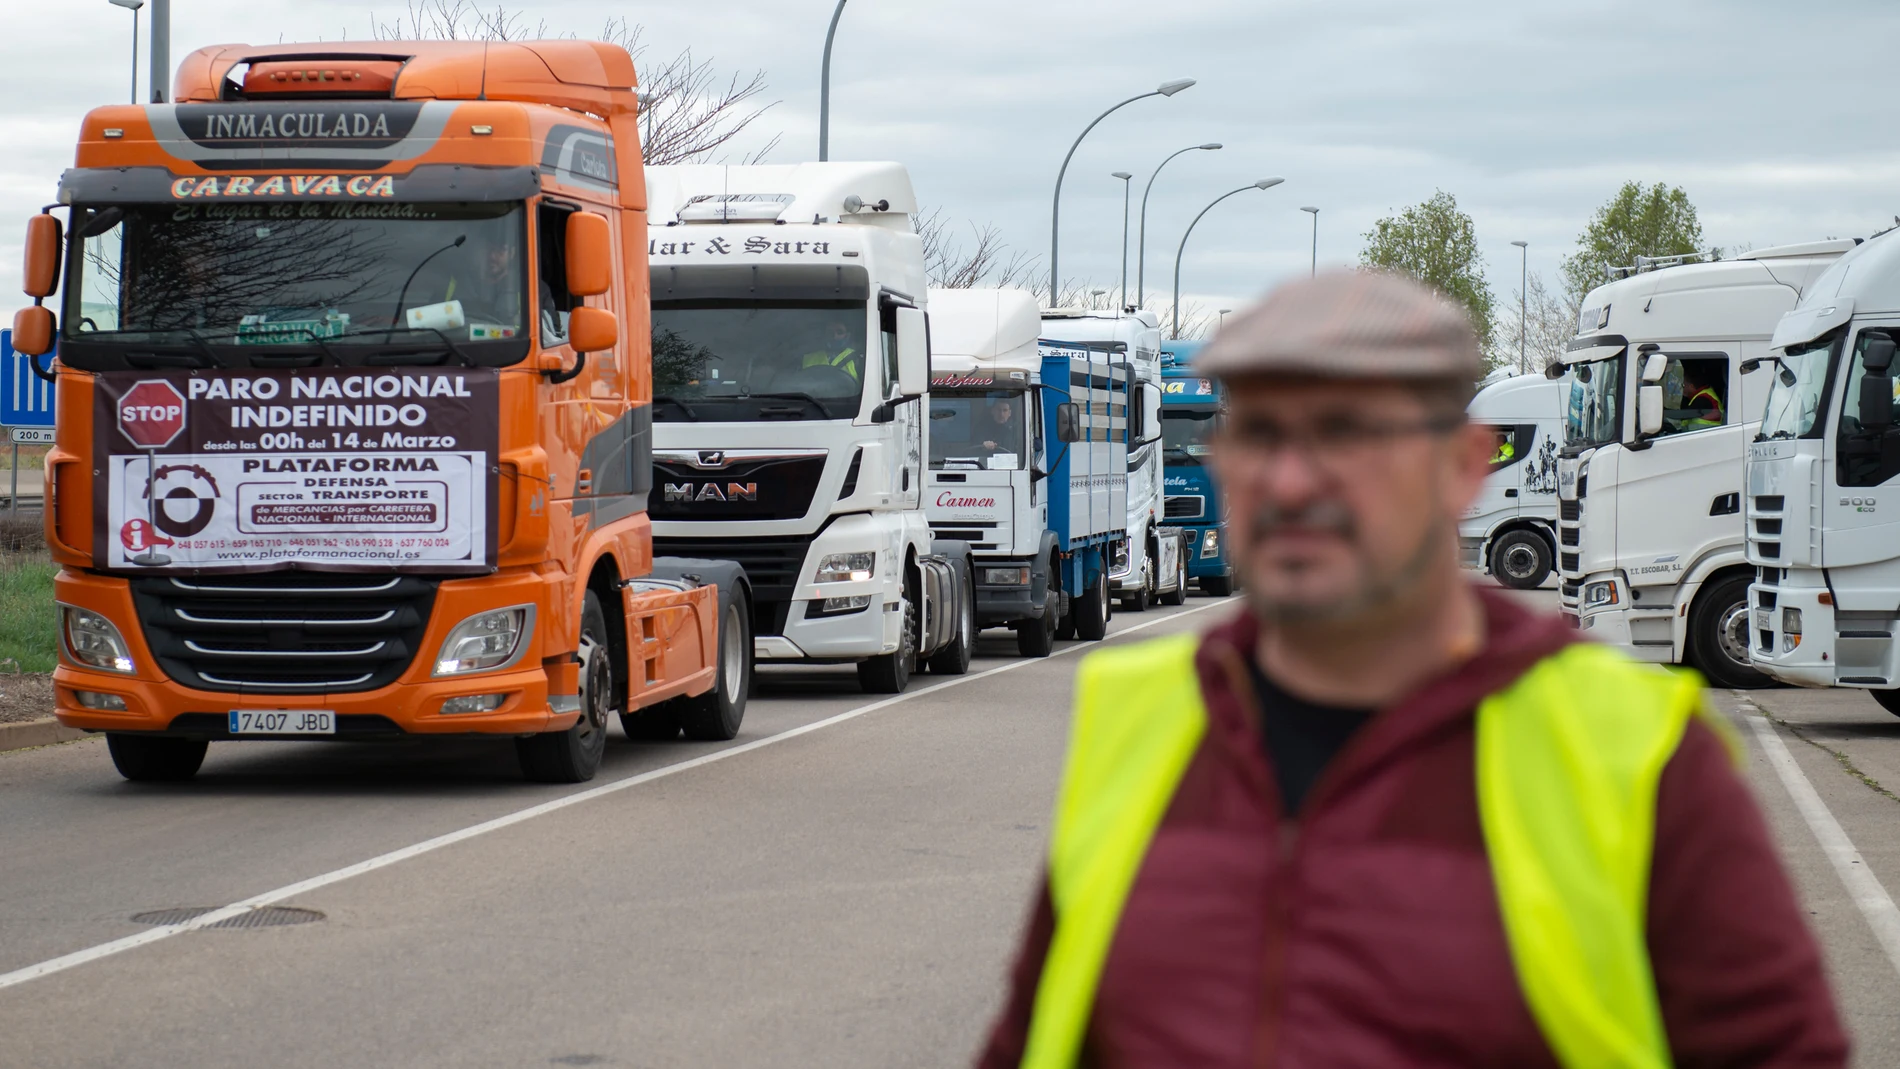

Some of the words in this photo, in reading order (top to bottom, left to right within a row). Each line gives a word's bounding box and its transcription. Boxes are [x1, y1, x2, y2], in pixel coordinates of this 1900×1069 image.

[205, 113, 390, 138] INMACULADA
[171, 175, 395, 198] CARAVACA
[172, 203, 197, 221] El
[205, 203, 262, 223] lugar
[269, 202, 294, 217] de
[298, 202, 320, 217] la
[648, 239, 696, 256] lar
[705, 235, 731, 255] &
[742, 235, 830, 256] Sara
[188, 377, 280, 400] PARO
[290, 375, 471, 398] NACIONAL
[931, 372, 993, 387] ntejano
[122, 405, 181, 422] STOP
[231, 404, 427, 428] INDEFINIDO
[19, 431, 39, 440] 200
[203, 441, 237, 450] desde
[239, 440, 257, 449] las
[259, 432, 304, 450] 00h
[307, 439, 326, 449] del
[331, 432, 360, 448] 14
[362, 439, 378, 448] de
[380, 432, 456, 448] Marzo
[243, 457, 439, 473] PLATAFORMA
[304, 477, 389, 487] DEFENSA
[1163, 476, 1187, 486] tela
[312, 490, 429, 500] TRANSPORTE
[664, 482, 757, 501] MAN
[936, 491, 996, 508] Carmen
[1839, 497, 1876, 506] 500
[256, 506, 270, 514] de
[272, 505, 346, 513] MERCANCIAS
[347, 506, 366, 515] por
[368, 505, 431, 513] CARRETERA
[257, 514, 321, 523] NACIONAL
[333, 514, 431, 523] INTERNACIONAL
[178, 540, 191, 549] 648
[194, 540, 207, 549] 057
[210, 540, 225, 548] 615
[232, 539, 247, 548] 659
[250, 539, 264, 547] 165
[267, 539, 281, 547] 710
[306, 539, 320, 547] 051
[345, 539, 359, 547] 616
[362, 539, 376, 547] 990
[401, 539, 415, 547] 637
[418, 539, 432, 547] 760
[435, 538, 449, 546] 024
[217, 547, 420, 560] www.plataformanacional.es
[241, 713, 288, 731] 7407
[295, 713, 330, 731] JBD
